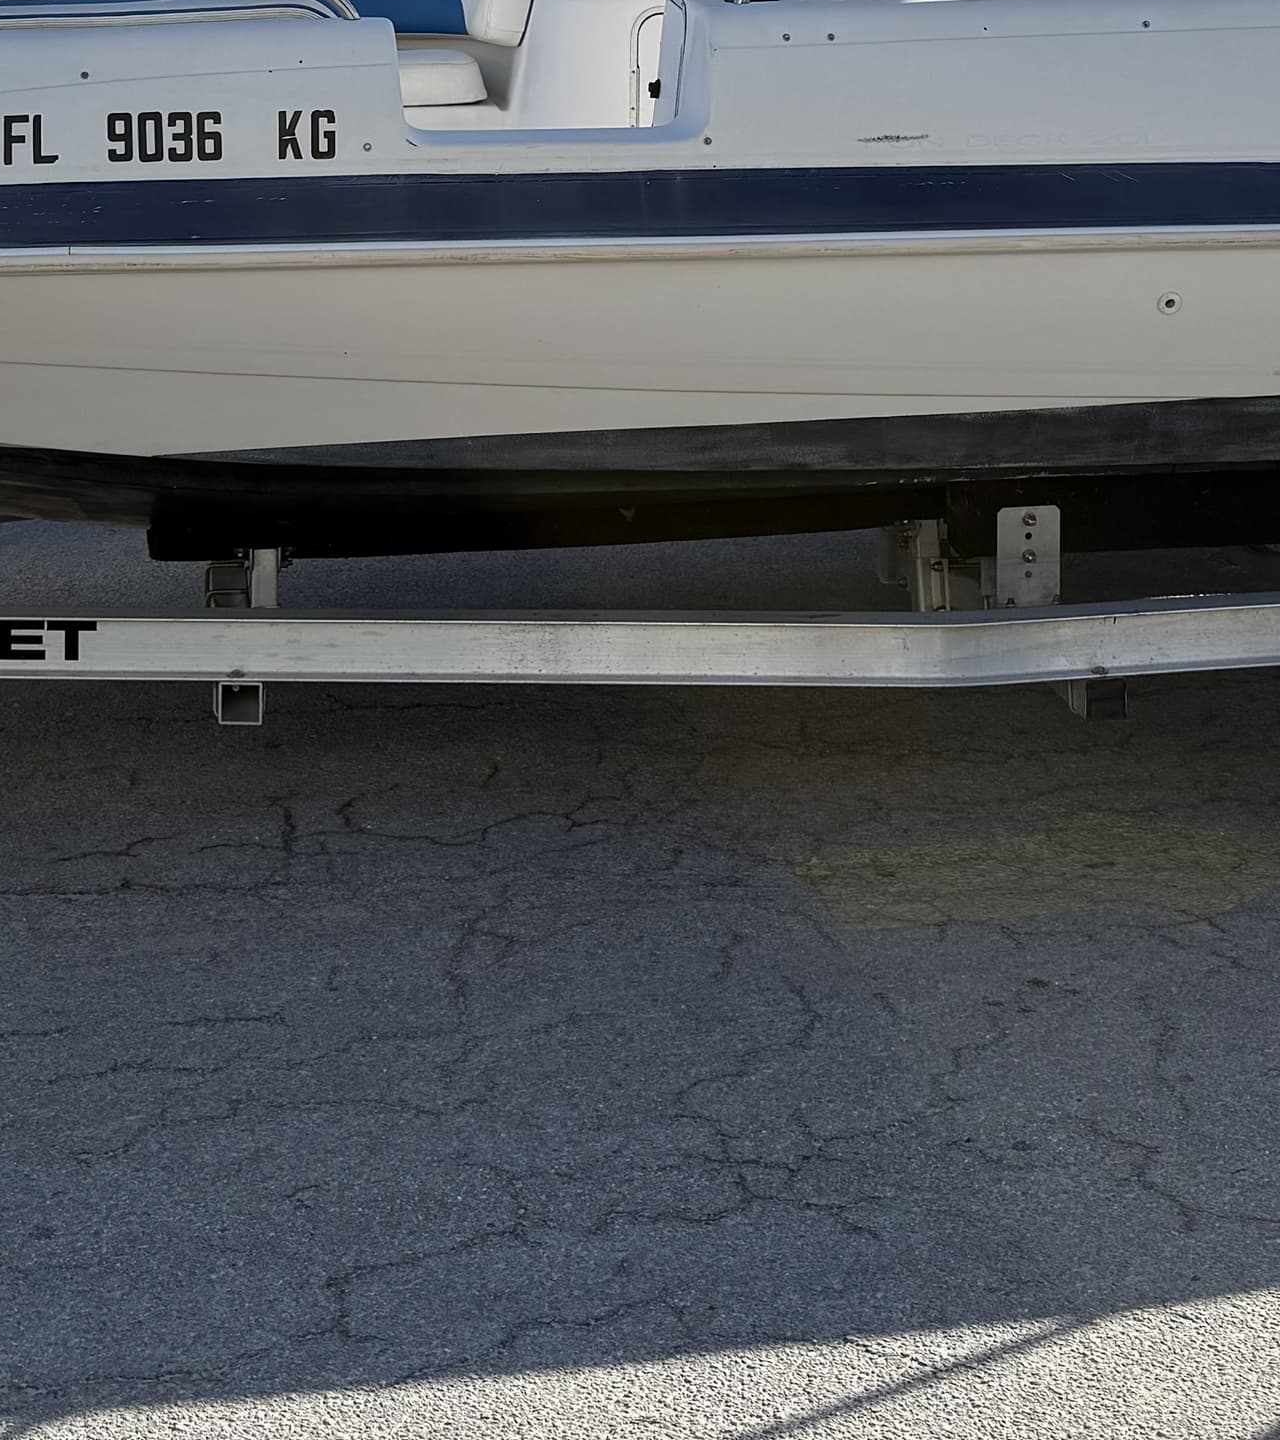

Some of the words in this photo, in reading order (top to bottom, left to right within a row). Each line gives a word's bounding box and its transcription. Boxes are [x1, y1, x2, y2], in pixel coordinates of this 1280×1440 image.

[3, 114, 59, 166] FL
[107, 111, 223, 163] 9036
[277, 109, 337, 160] KG
